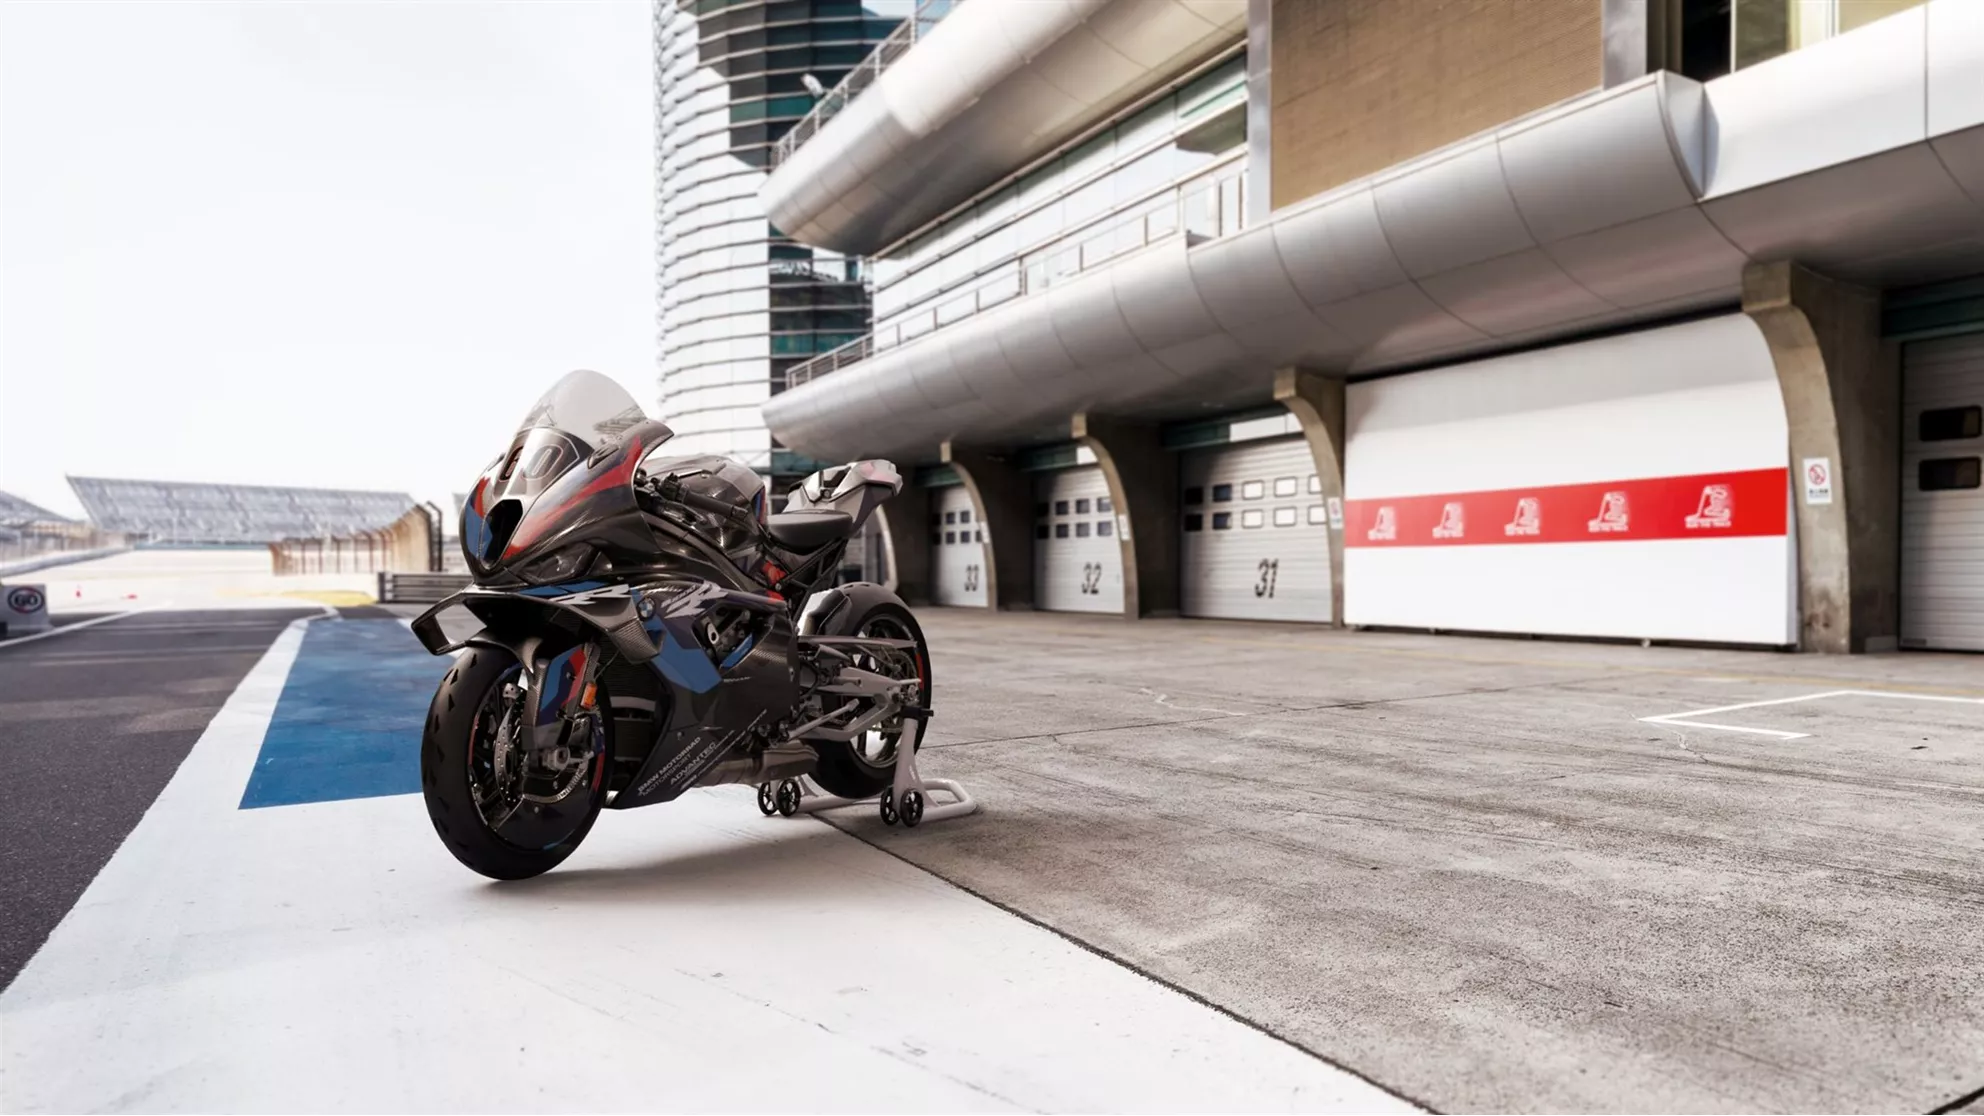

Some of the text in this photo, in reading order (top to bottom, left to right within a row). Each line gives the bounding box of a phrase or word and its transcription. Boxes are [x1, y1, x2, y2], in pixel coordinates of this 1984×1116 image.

[964, 564, 979, 592] 33
[1081, 562, 1102, 595] 32
[1254, 558, 1279, 599] 31
[637, 773, 659, 792] BMW
[658, 736, 701, 774] MOTORRAD
